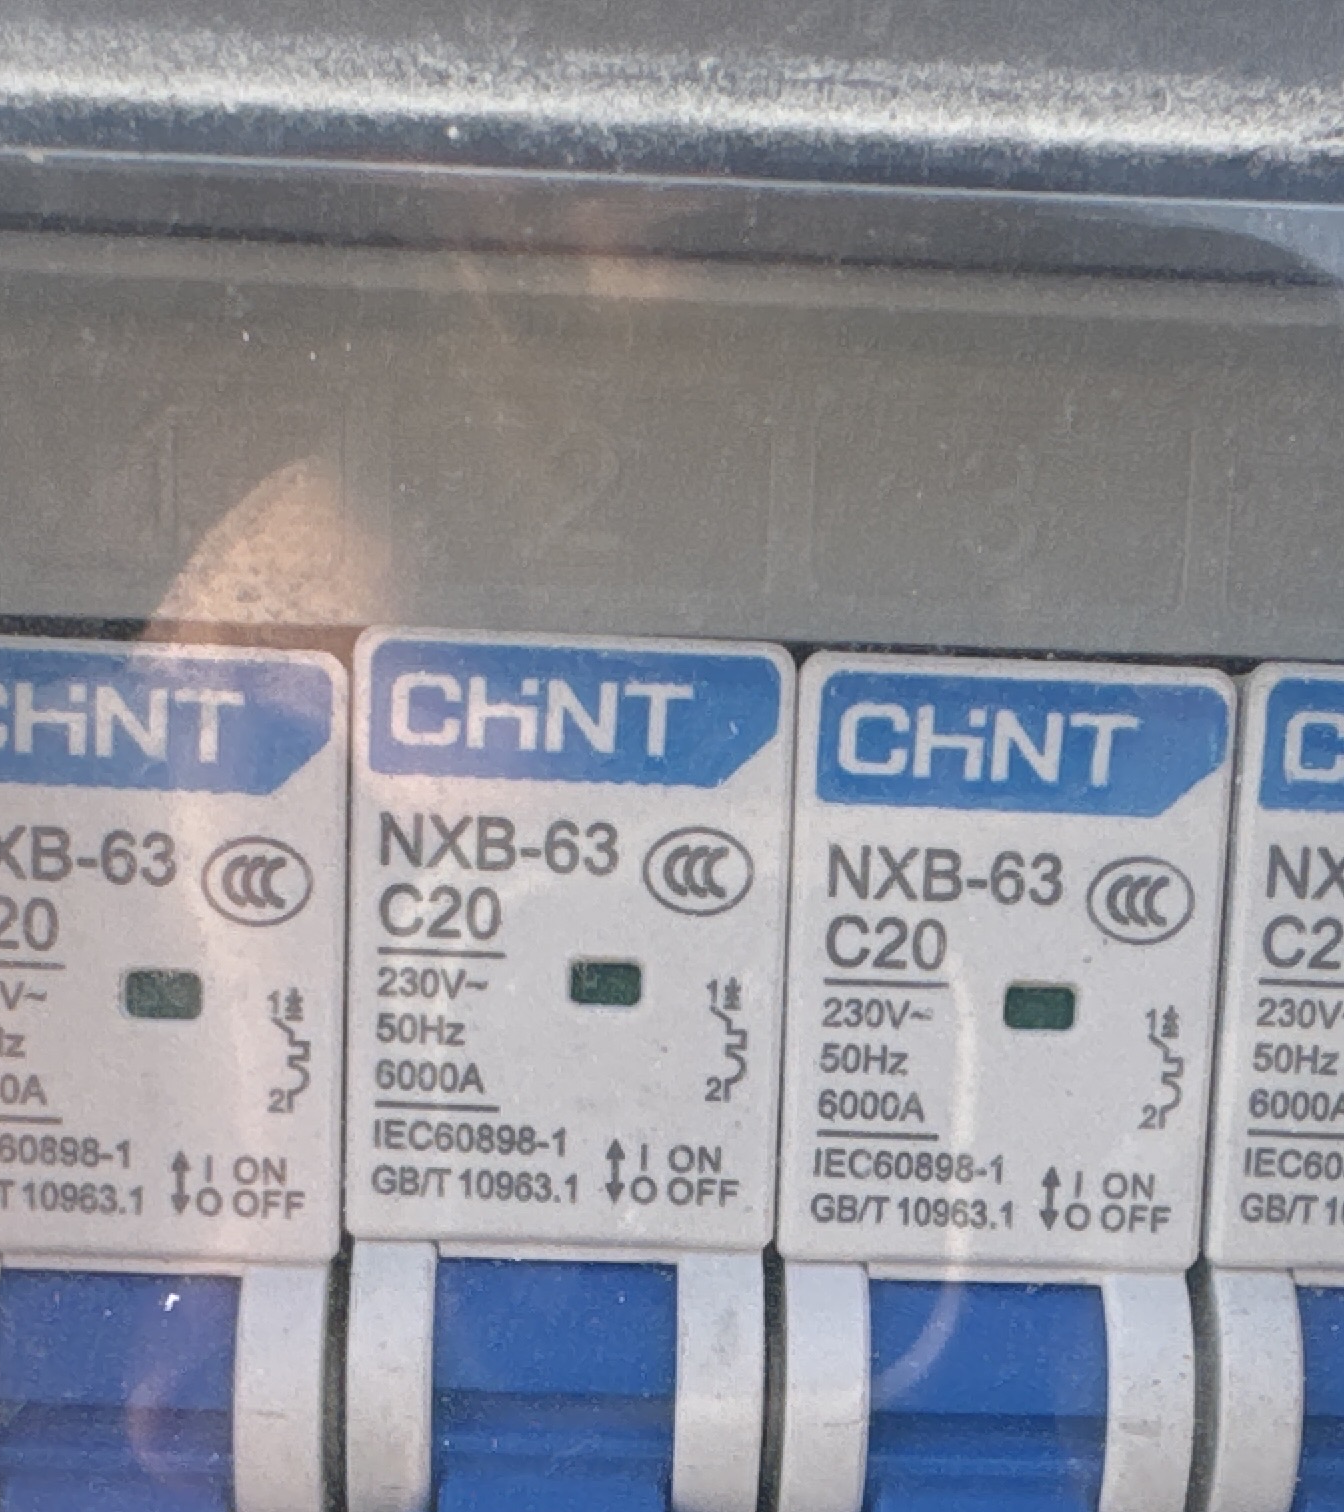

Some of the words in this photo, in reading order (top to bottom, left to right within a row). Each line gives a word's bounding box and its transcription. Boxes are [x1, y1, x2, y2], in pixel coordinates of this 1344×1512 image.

[379, 810, 619, 876] NXB-63
[826, 843, 1064, 907] NXB-63
[377, 882, 503, 941] C20
[824, 914, 949, 973] C20
[375, 1013, 465, 1048] 50Hz
[374, 1059, 486, 1095] 6000A
[819, 1042, 909, 1077] 50Hz
[1252, 1042, 1340, 1077] 50Hz
[266, 1087, 287, 1114] 2
[704, 1077, 723, 1102] 2
[816, 1089, 926, 1125] 6000A
[1138, 1104, 1158, 1131] 2
[372, 1117, 568, 1158] IEC60898-1
[232, 1154, 288, 1186] ON
[667, 1143, 723, 1175] ON
[811, 1147, 1005, 1185] IEC60898-1
[22, 1182, 145, 1216] 10963.1
[458, 1170, 579, 1205] 10963.1
[666, 1175, 740, 1207] OFF
[1102, 1171, 1156, 1200] ON
[231, 1188, 307, 1221] OFF
[897, 1197, 1015, 1231] 10963.1
[1099, 1204, 1173, 1234] OFF
